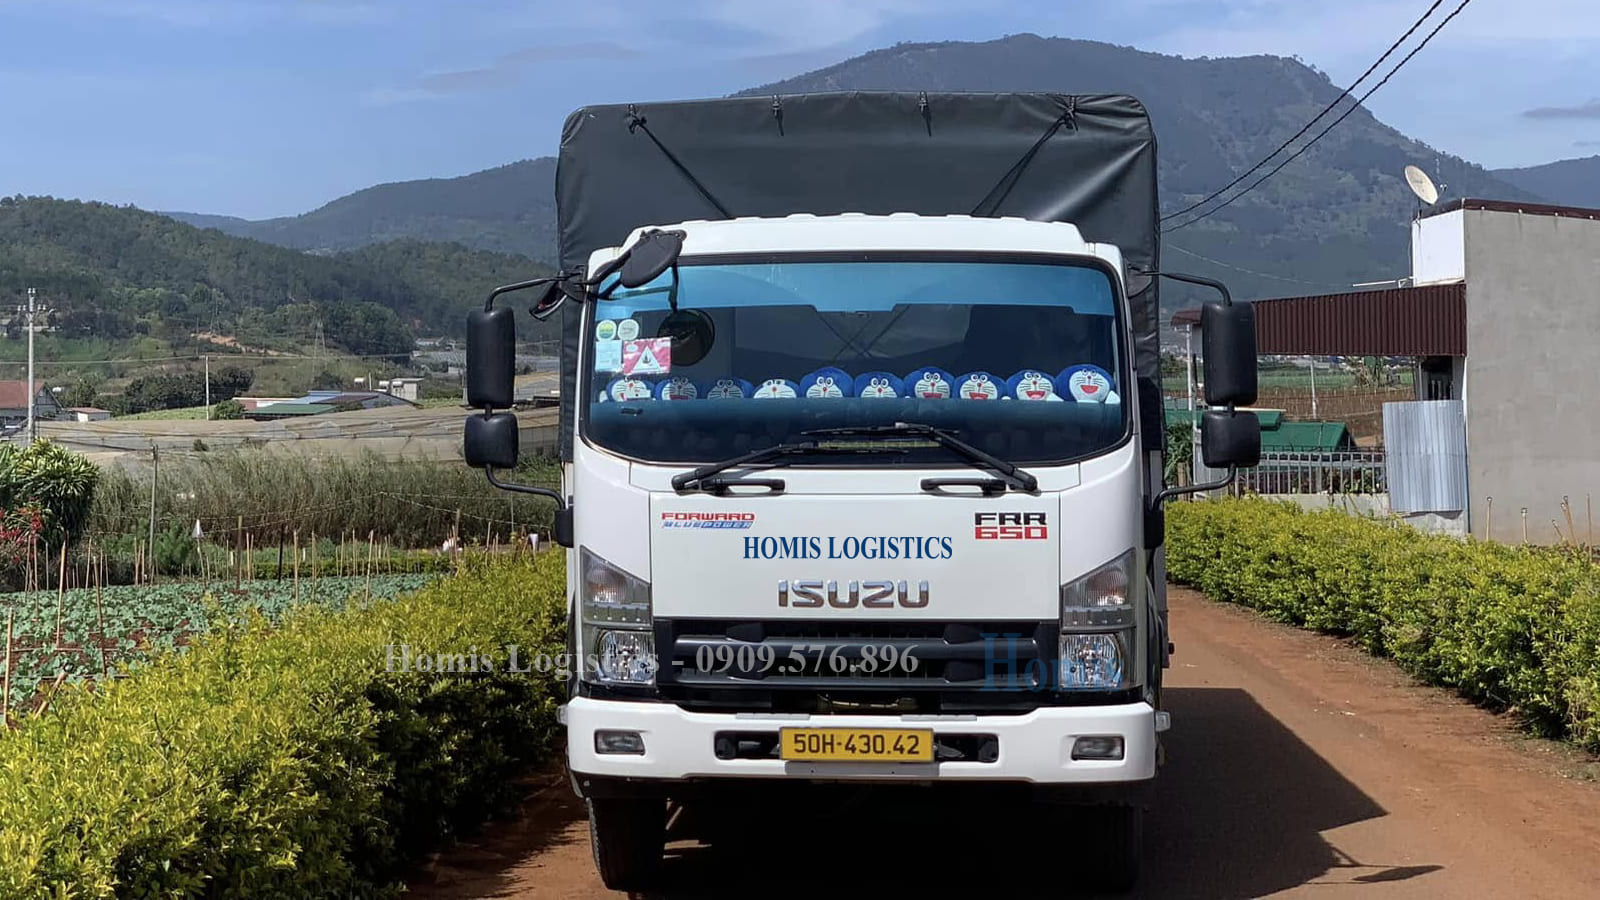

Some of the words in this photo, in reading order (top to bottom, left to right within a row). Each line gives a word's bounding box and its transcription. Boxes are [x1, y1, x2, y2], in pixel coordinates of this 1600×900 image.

[661, 512, 756, 521] FORWARD
[975, 512, 1047, 526] FRR
[975, 526, 1048, 540] 650
[778, 578, 930, 609] ISUZU
[793, 733, 920, 755] 50H-430.42
